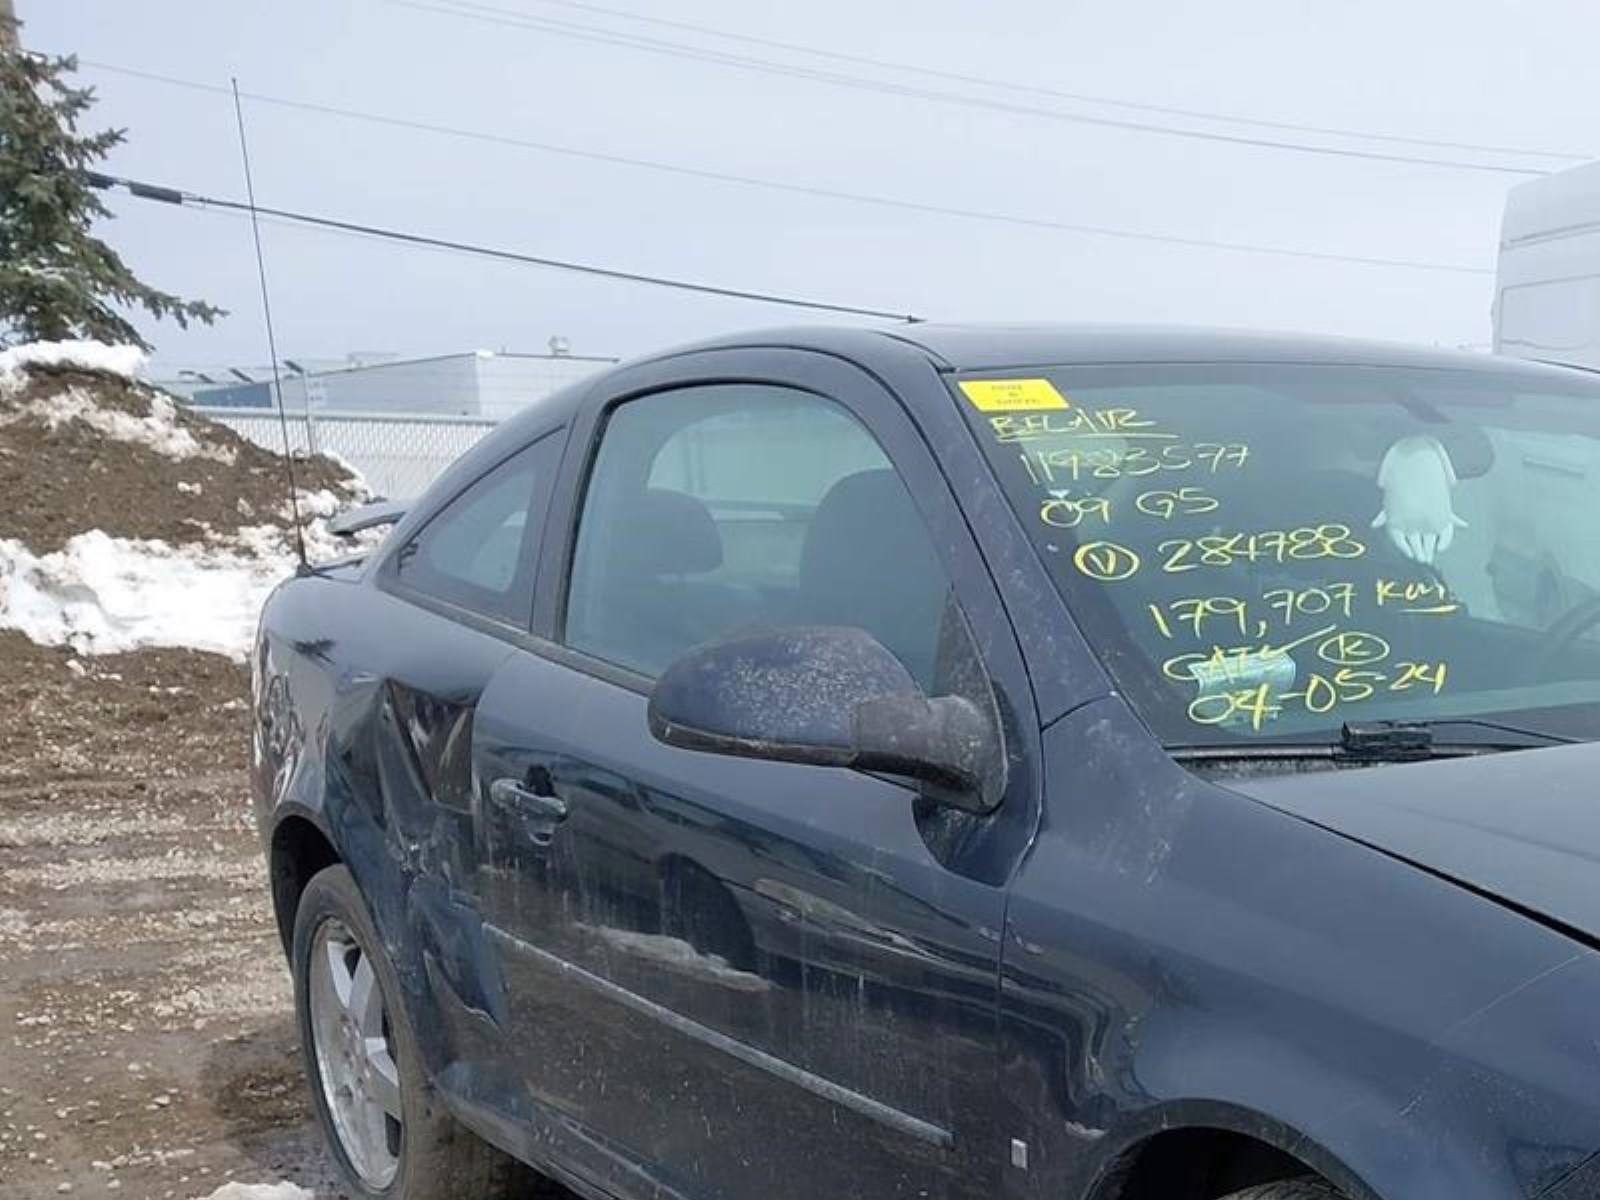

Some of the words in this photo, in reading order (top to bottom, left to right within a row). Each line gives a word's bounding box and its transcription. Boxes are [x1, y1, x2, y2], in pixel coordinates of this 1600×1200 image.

[1019, 443, 1249, 485] 11983577
[1040, 494, 1111, 528] 09
[1136, 487, 1220, 519] G5
[1157, 524, 1367, 573] 284788
[1149, 582, 1358, 640] 179,707
[1187, 662, 1447, 731] 04-05-24
